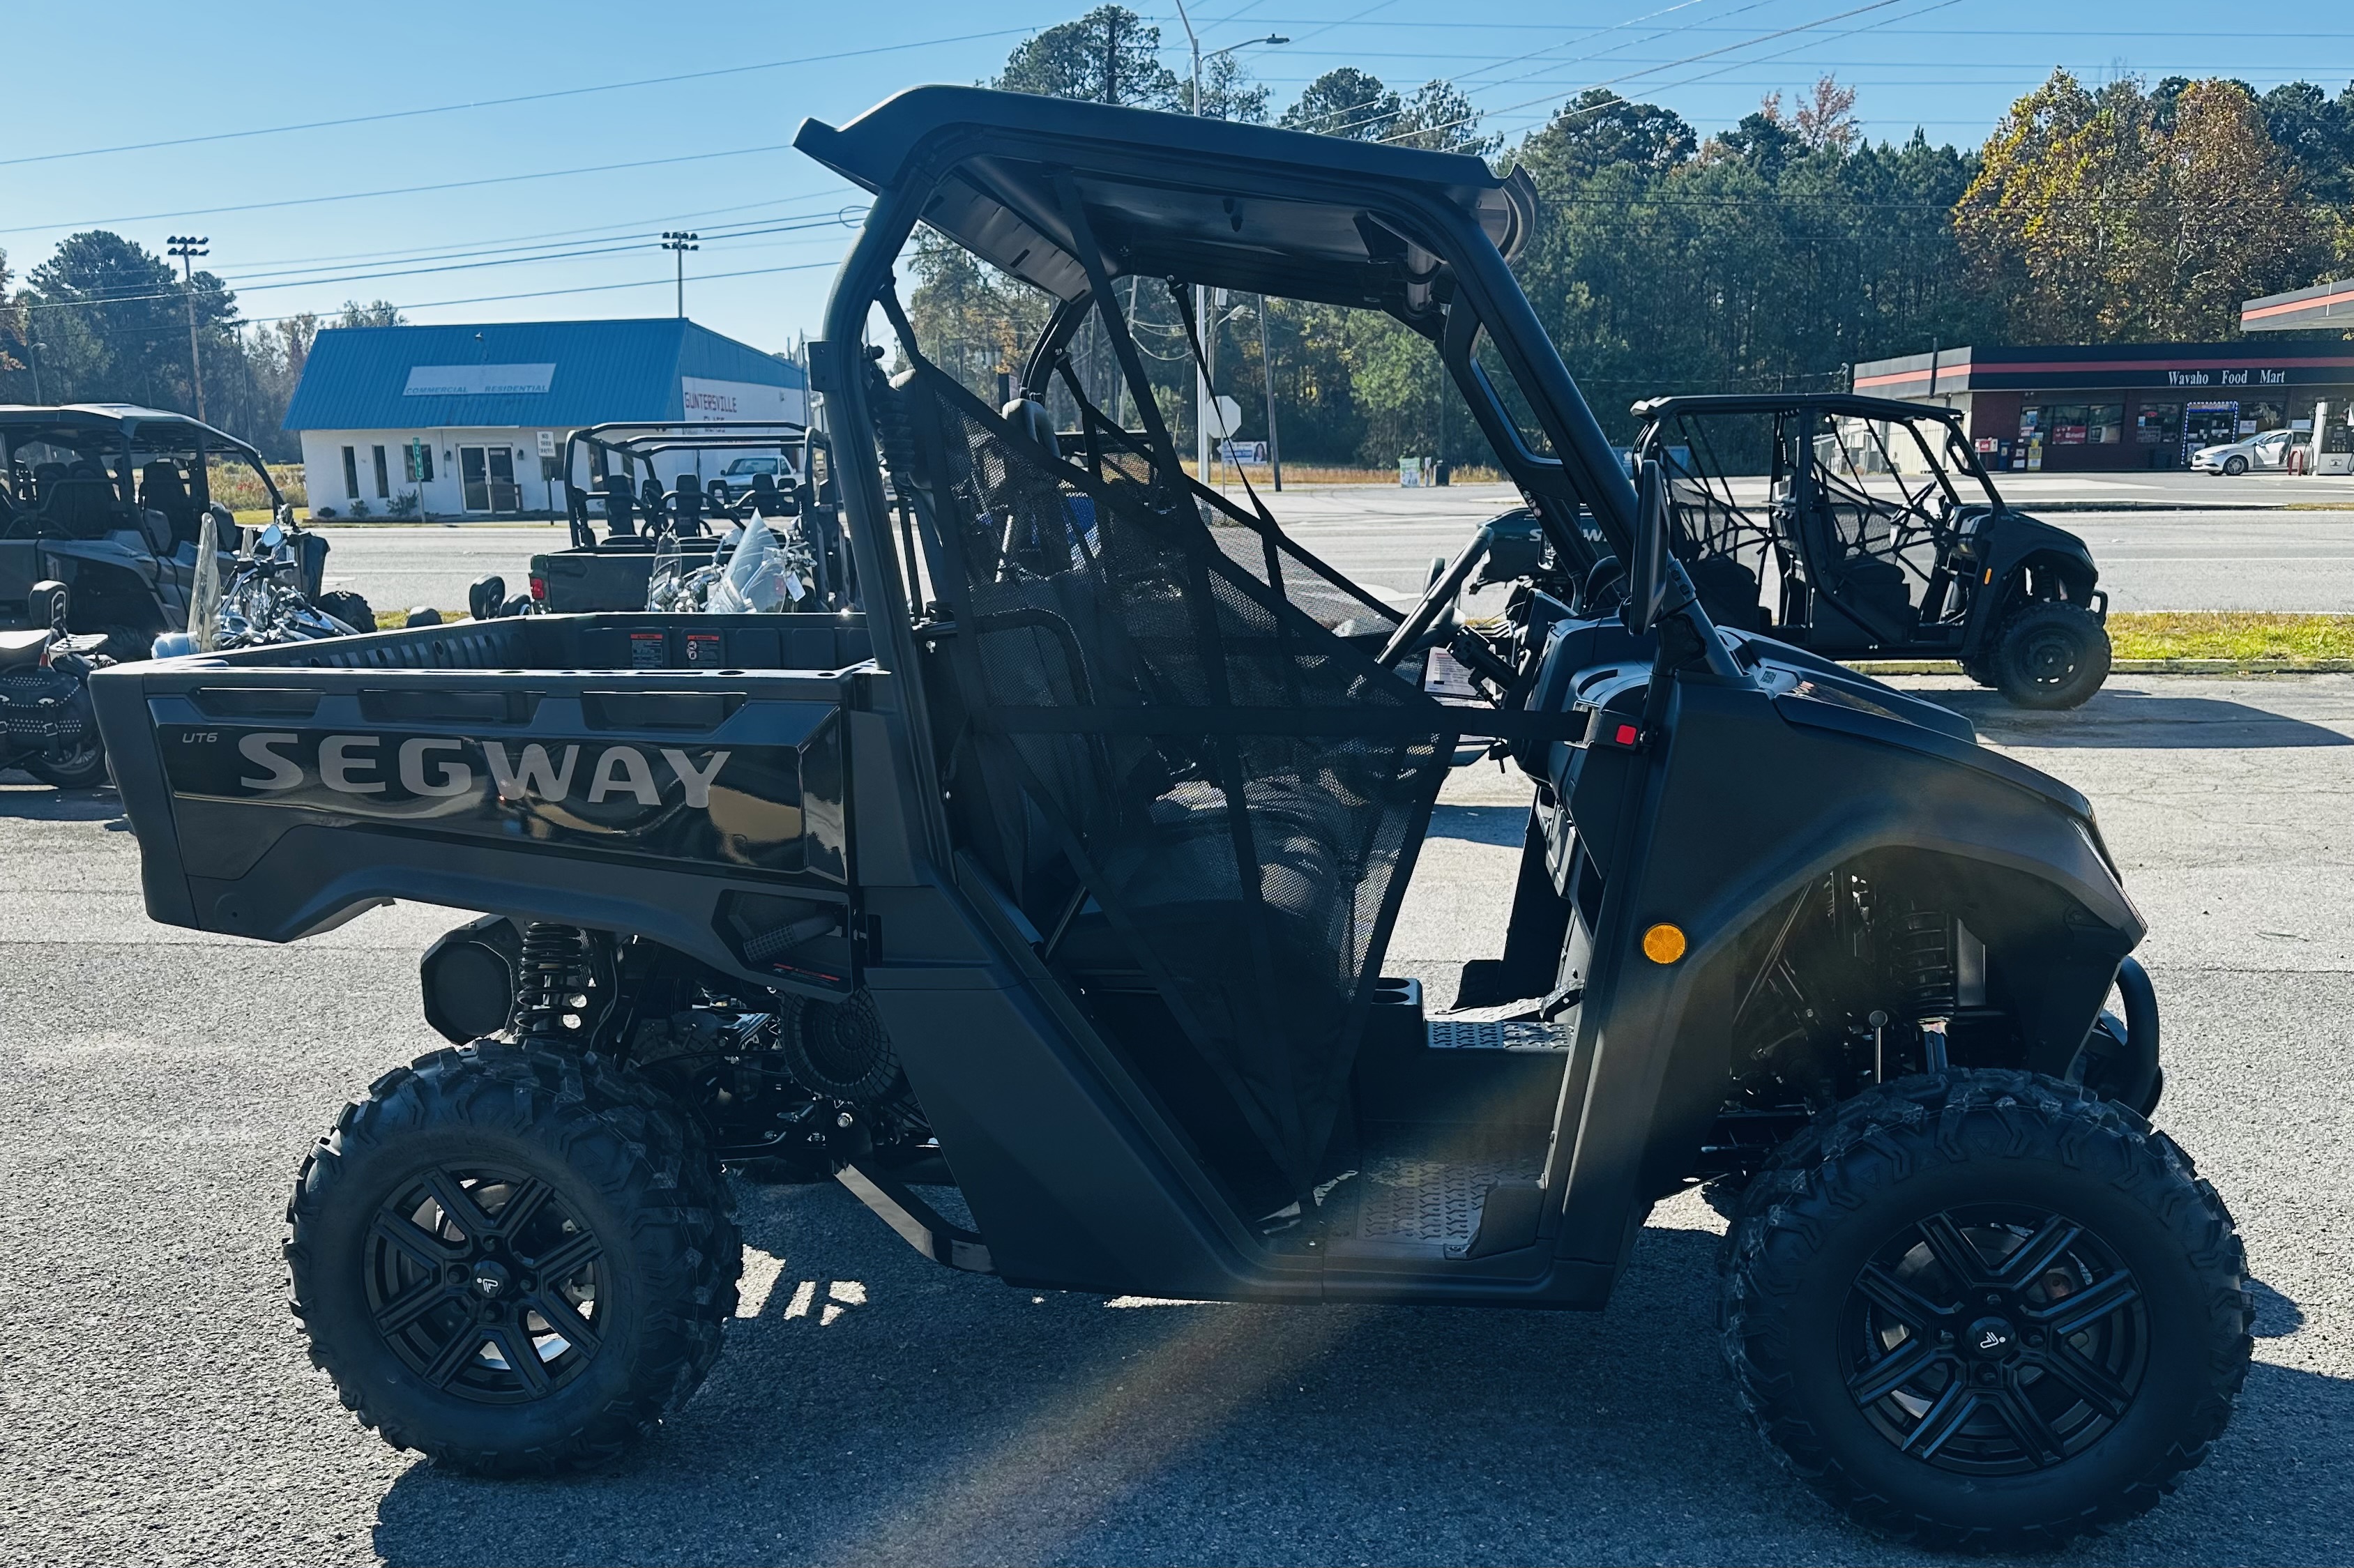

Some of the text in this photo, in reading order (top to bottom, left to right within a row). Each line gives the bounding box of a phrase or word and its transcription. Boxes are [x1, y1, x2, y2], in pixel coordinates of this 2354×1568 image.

[2169, 370, 2285, 385] Wavaho Food Mart
[685, 392, 737, 413] GUNTERSVILLE
[182, 733, 218, 743] UT6
[238, 733, 731, 808] SEGWAY
